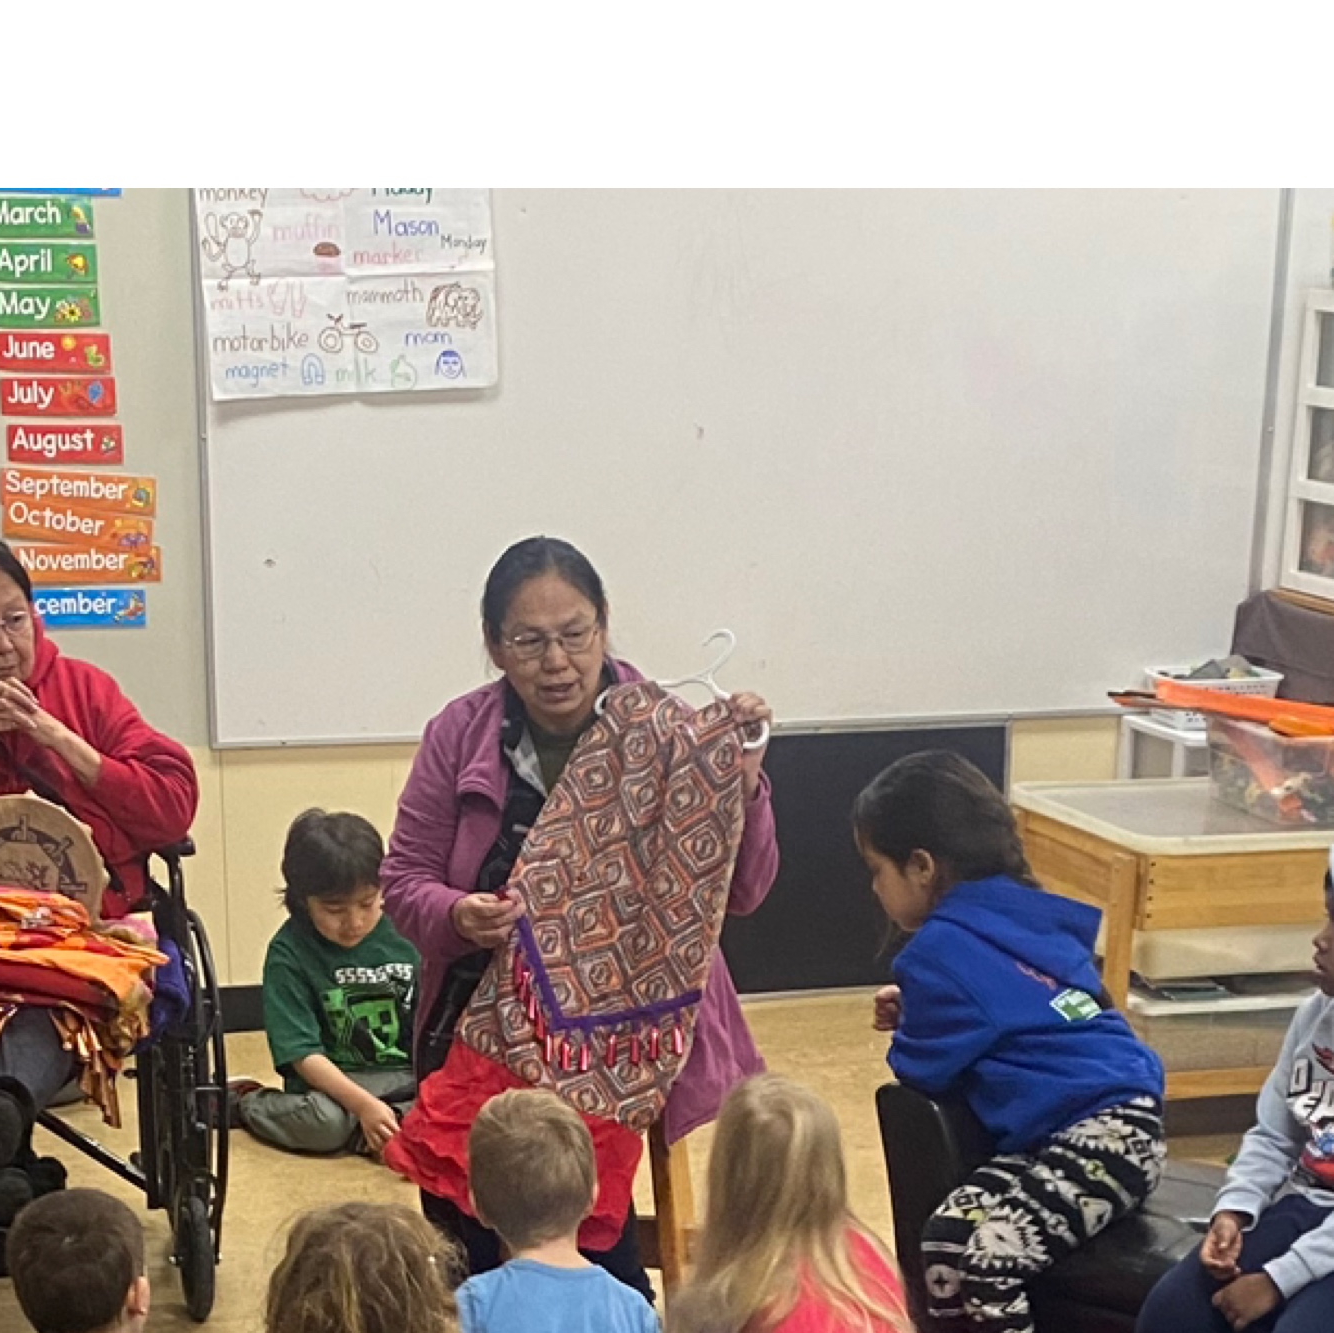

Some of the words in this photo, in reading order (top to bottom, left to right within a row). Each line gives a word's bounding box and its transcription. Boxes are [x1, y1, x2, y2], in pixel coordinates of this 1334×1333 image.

[373, 209, 439, 236] Mason
[440, 234, 487, 255] Monday
[2, 335, 55, 360] June
[226, 356, 289, 388] magnet
[6, 380, 54, 410] July
[12, 429, 95, 458] August
[5, 472, 129, 501] September
[9, 501, 105, 537] October
[19, 548, 128, 571] November
[35, 592, 117, 614] cember
